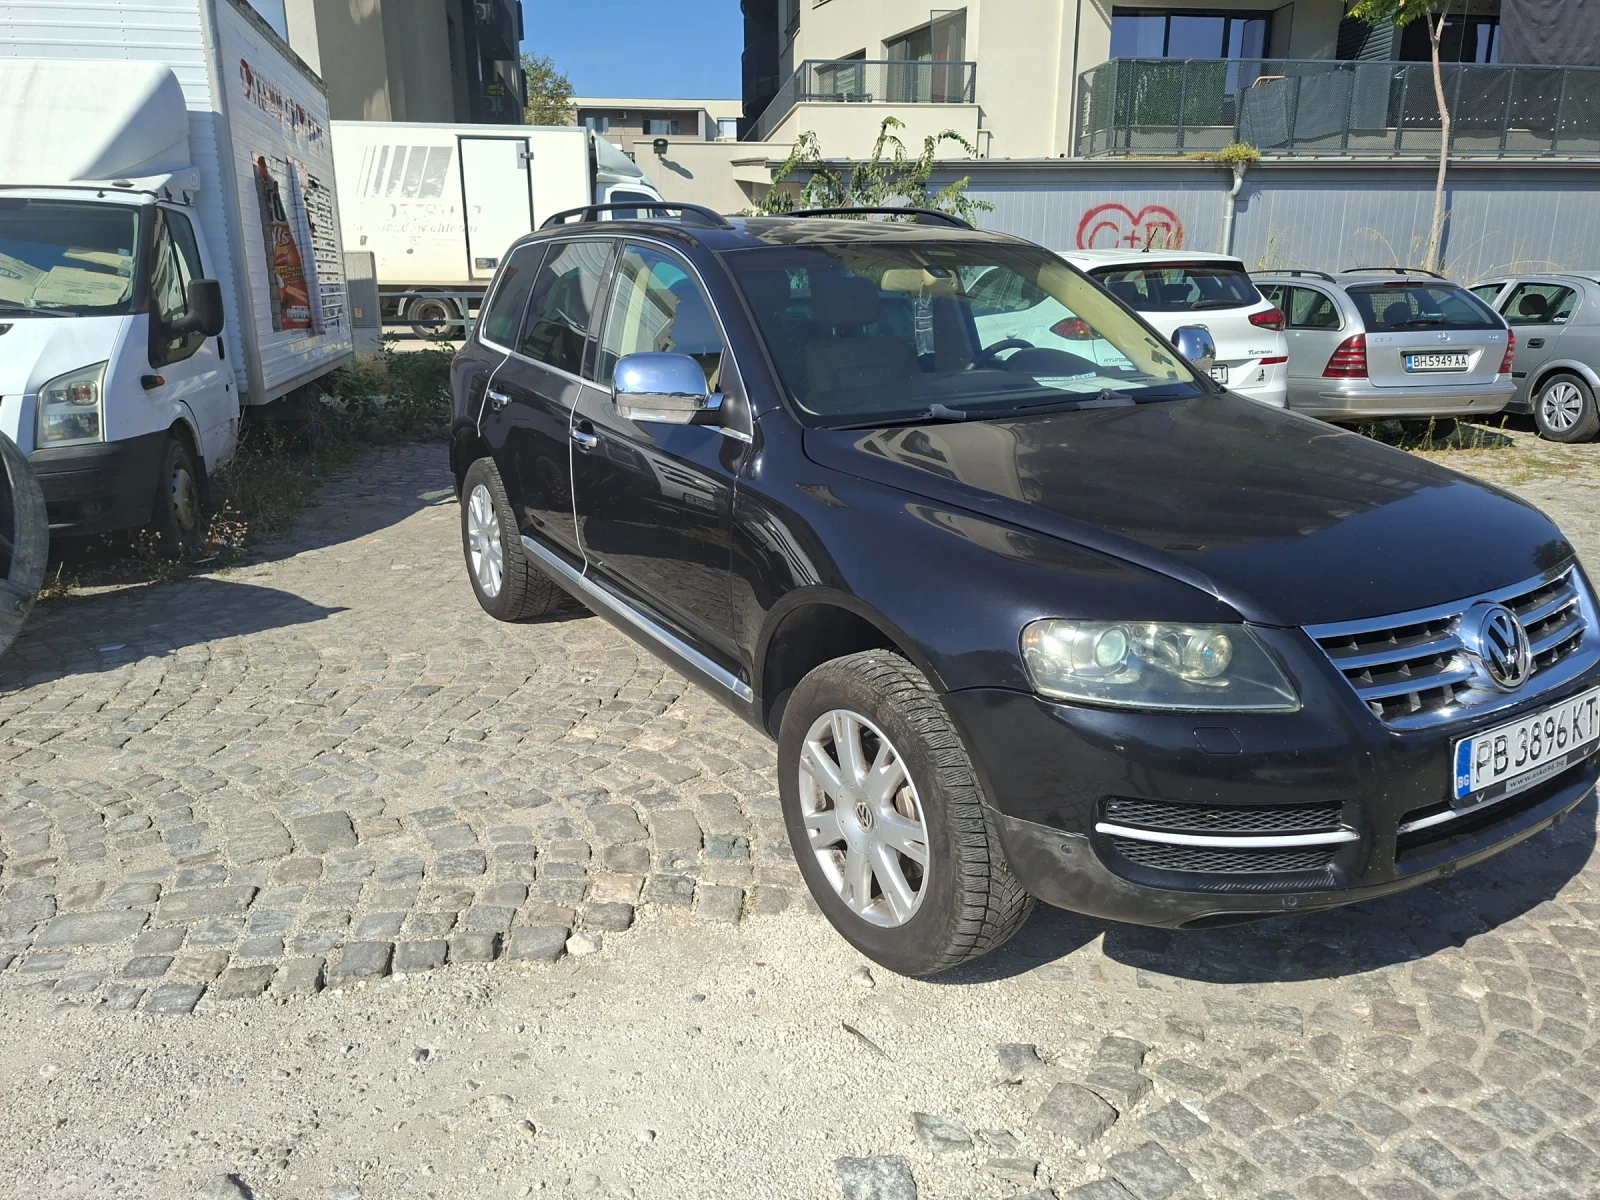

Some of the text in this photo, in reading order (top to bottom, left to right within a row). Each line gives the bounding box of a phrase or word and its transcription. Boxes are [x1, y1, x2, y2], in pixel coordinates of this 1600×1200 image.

[1428, 355, 1452, 367] 5949
[1455, 355, 1467, 366] AA
[1475, 696, 1597, 783] PB 3896 KT
[1457, 774, 1470, 789] BG
